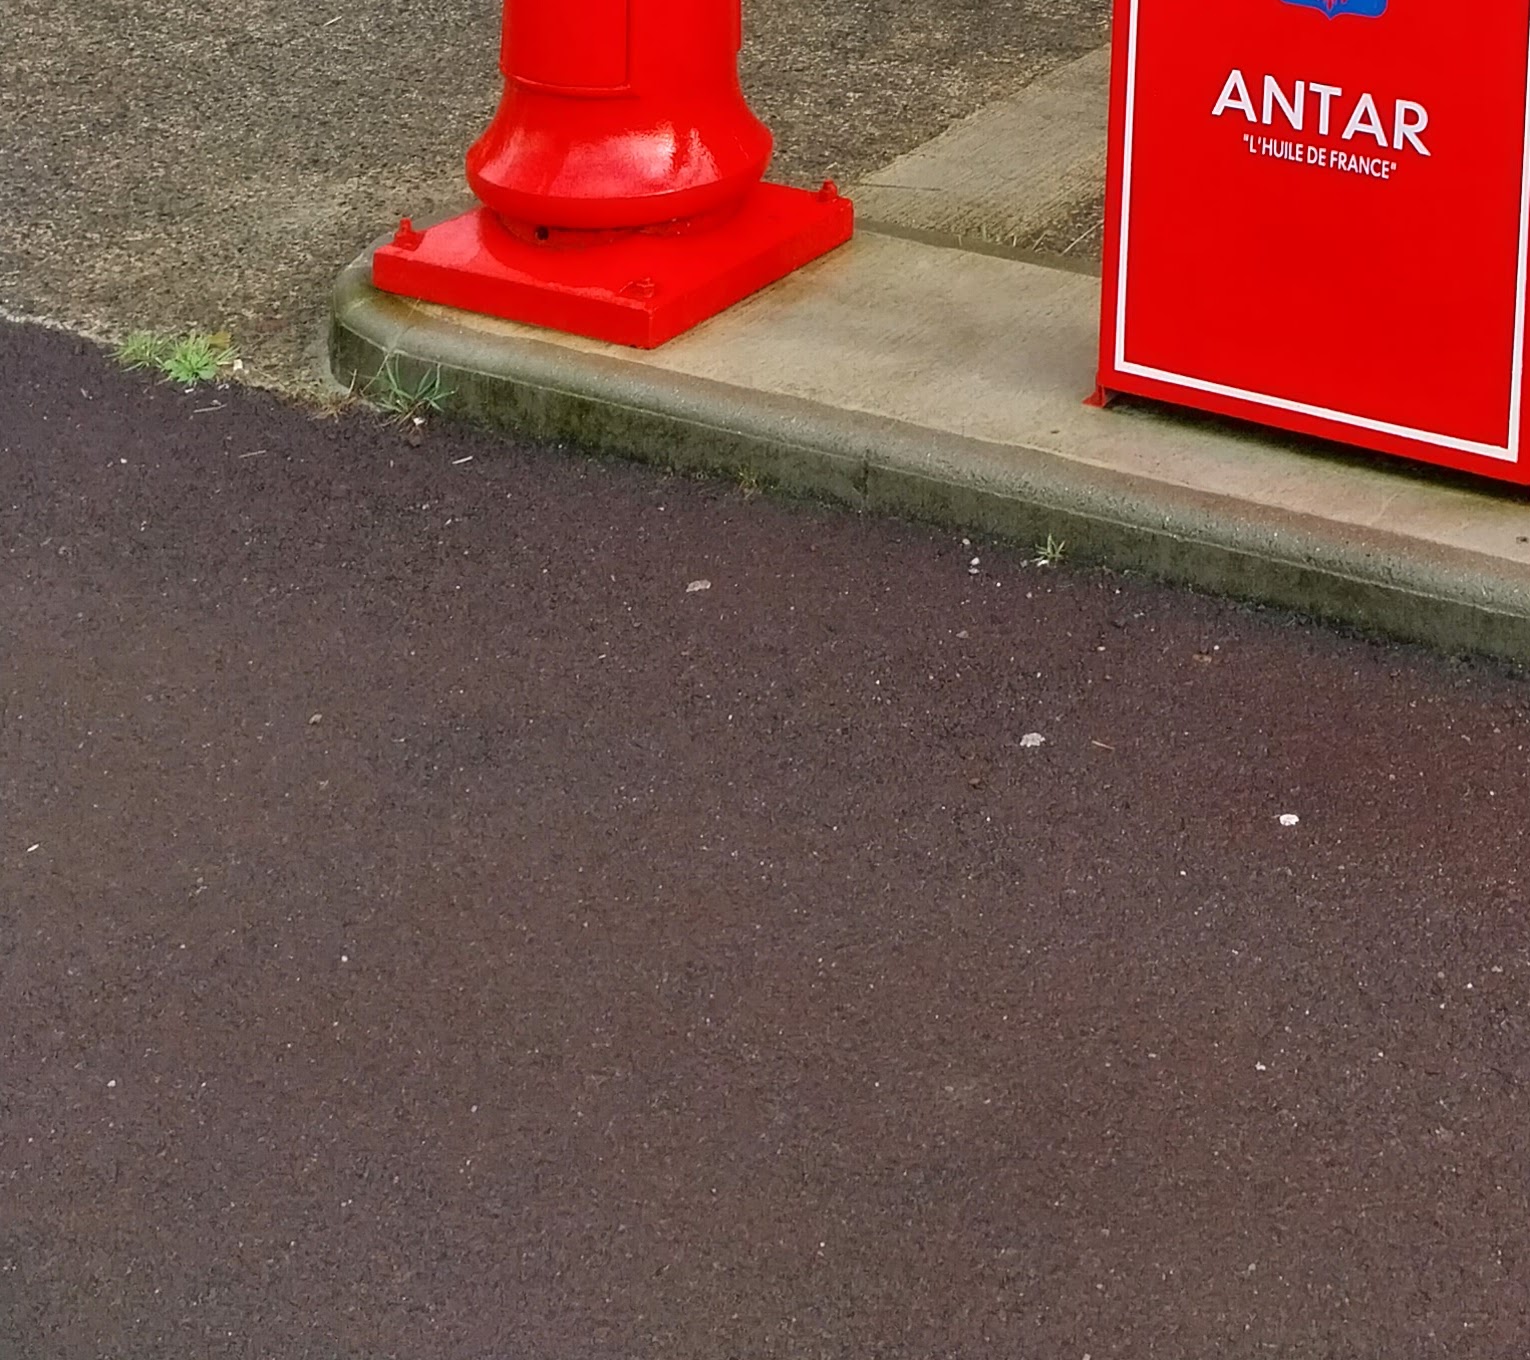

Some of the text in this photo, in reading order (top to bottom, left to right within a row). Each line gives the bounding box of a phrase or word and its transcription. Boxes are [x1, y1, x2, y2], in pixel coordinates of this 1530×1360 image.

[1211, 69, 1432, 157] ANTAR
[1243, 133, 1397, 180] "L'HUILE DE FRANCE"
